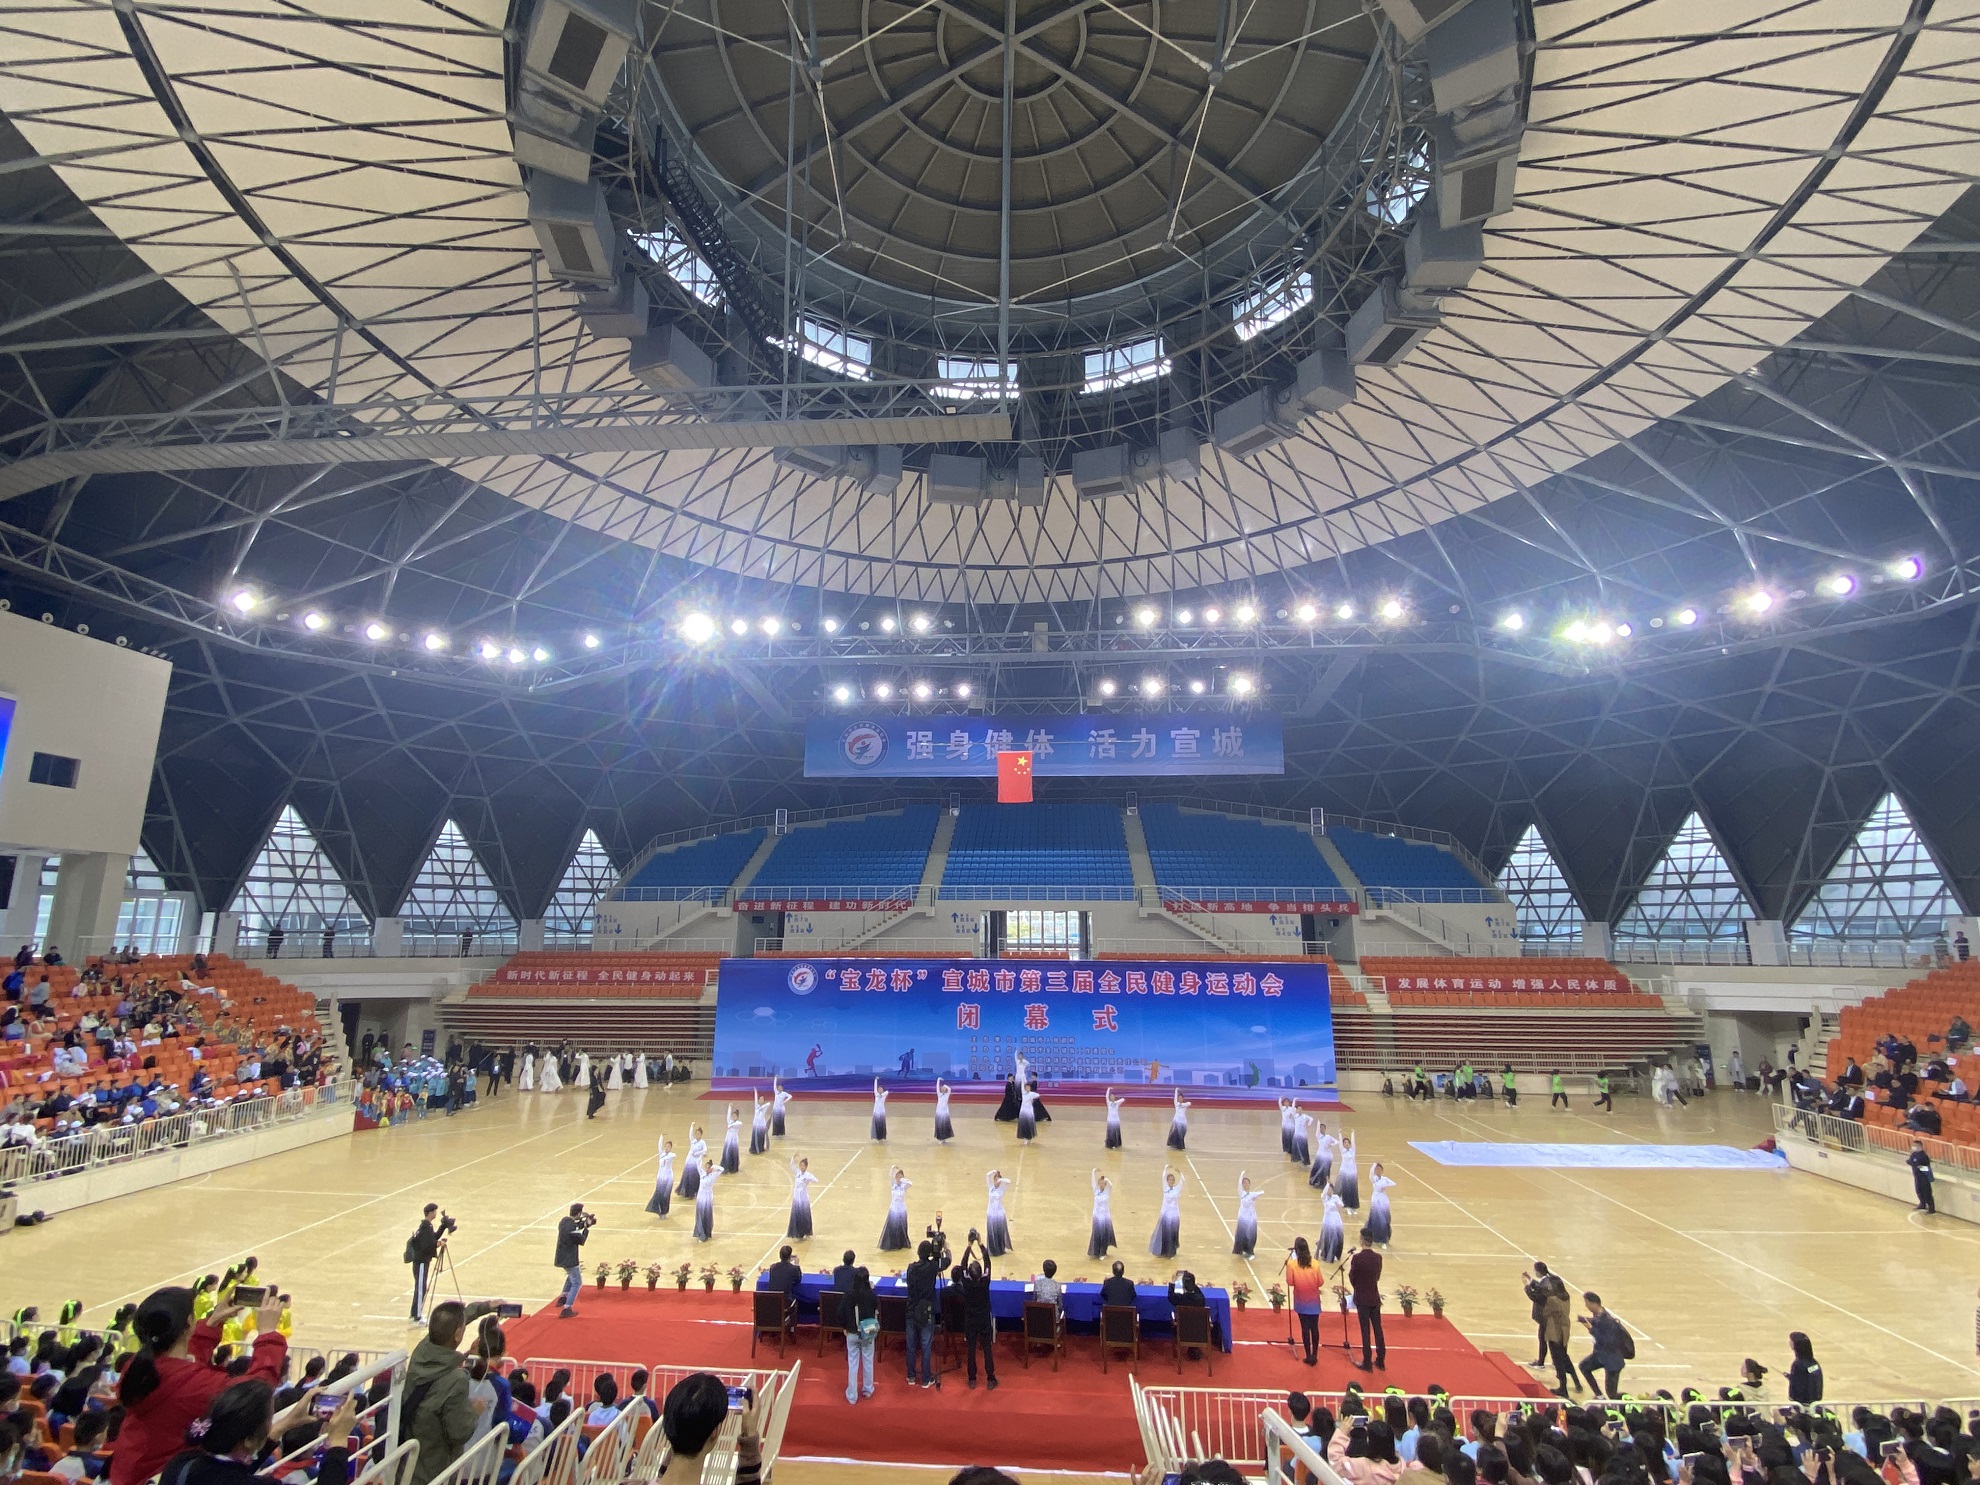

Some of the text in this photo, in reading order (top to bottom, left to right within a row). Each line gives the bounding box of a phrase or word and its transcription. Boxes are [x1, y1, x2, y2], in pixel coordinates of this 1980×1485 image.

[906, 728, 1055, 760] 强身健体
[1088, 726, 1246, 759] 活力宣城
[738, 901, 908, 911] 奋进新征程 建功新时代
[1173, 902, 1350, 913] 打造新高地 争当排头兵
[506, 969, 695, 981] 新时代新征程 全民健身动起来
[1398, 977, 1617, 991] 发展体育运动 增强人民体质
[956, 1002, 1118, 1031] 闭幕式
